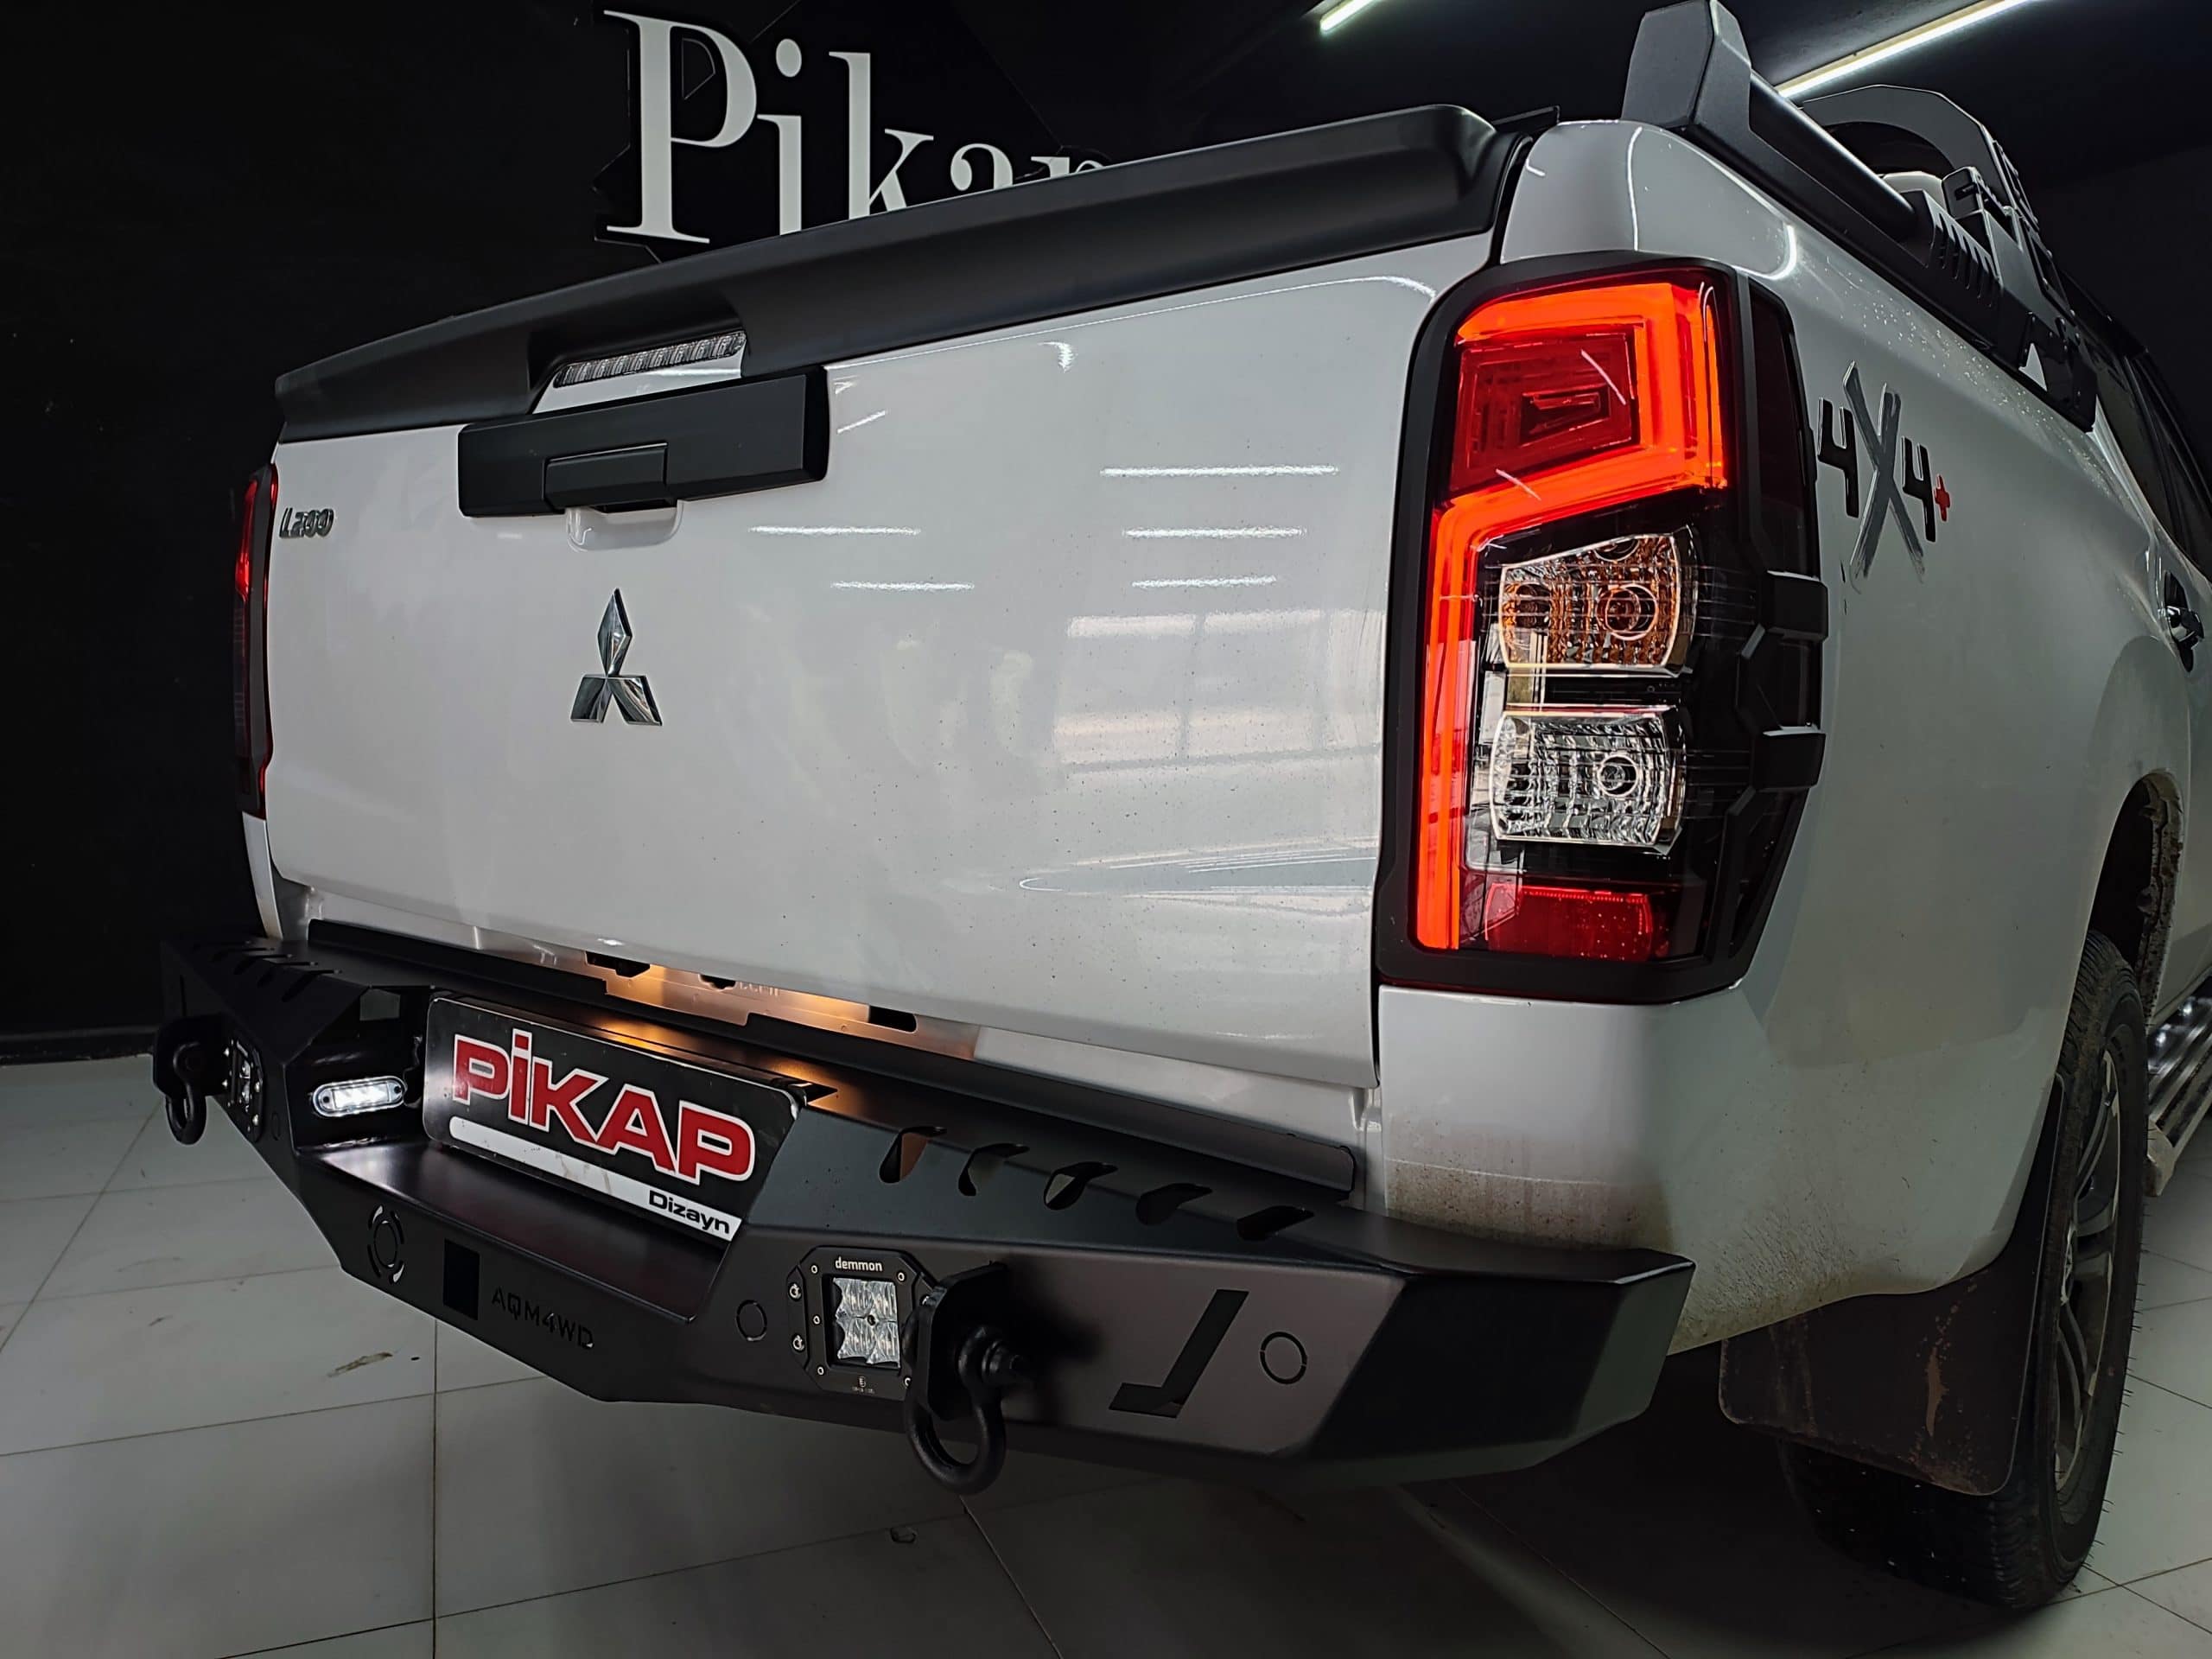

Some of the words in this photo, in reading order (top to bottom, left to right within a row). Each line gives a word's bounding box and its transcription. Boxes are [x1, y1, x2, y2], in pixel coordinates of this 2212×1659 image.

[604, 10, 1109, 244] Pik
[279, 507, 334, 538] L200
[648, 1189, 731, 1235] Dizayn
[835, 1255, 883, 1273] demmon
[491, 1285, 594, 1350] AQM4WD
